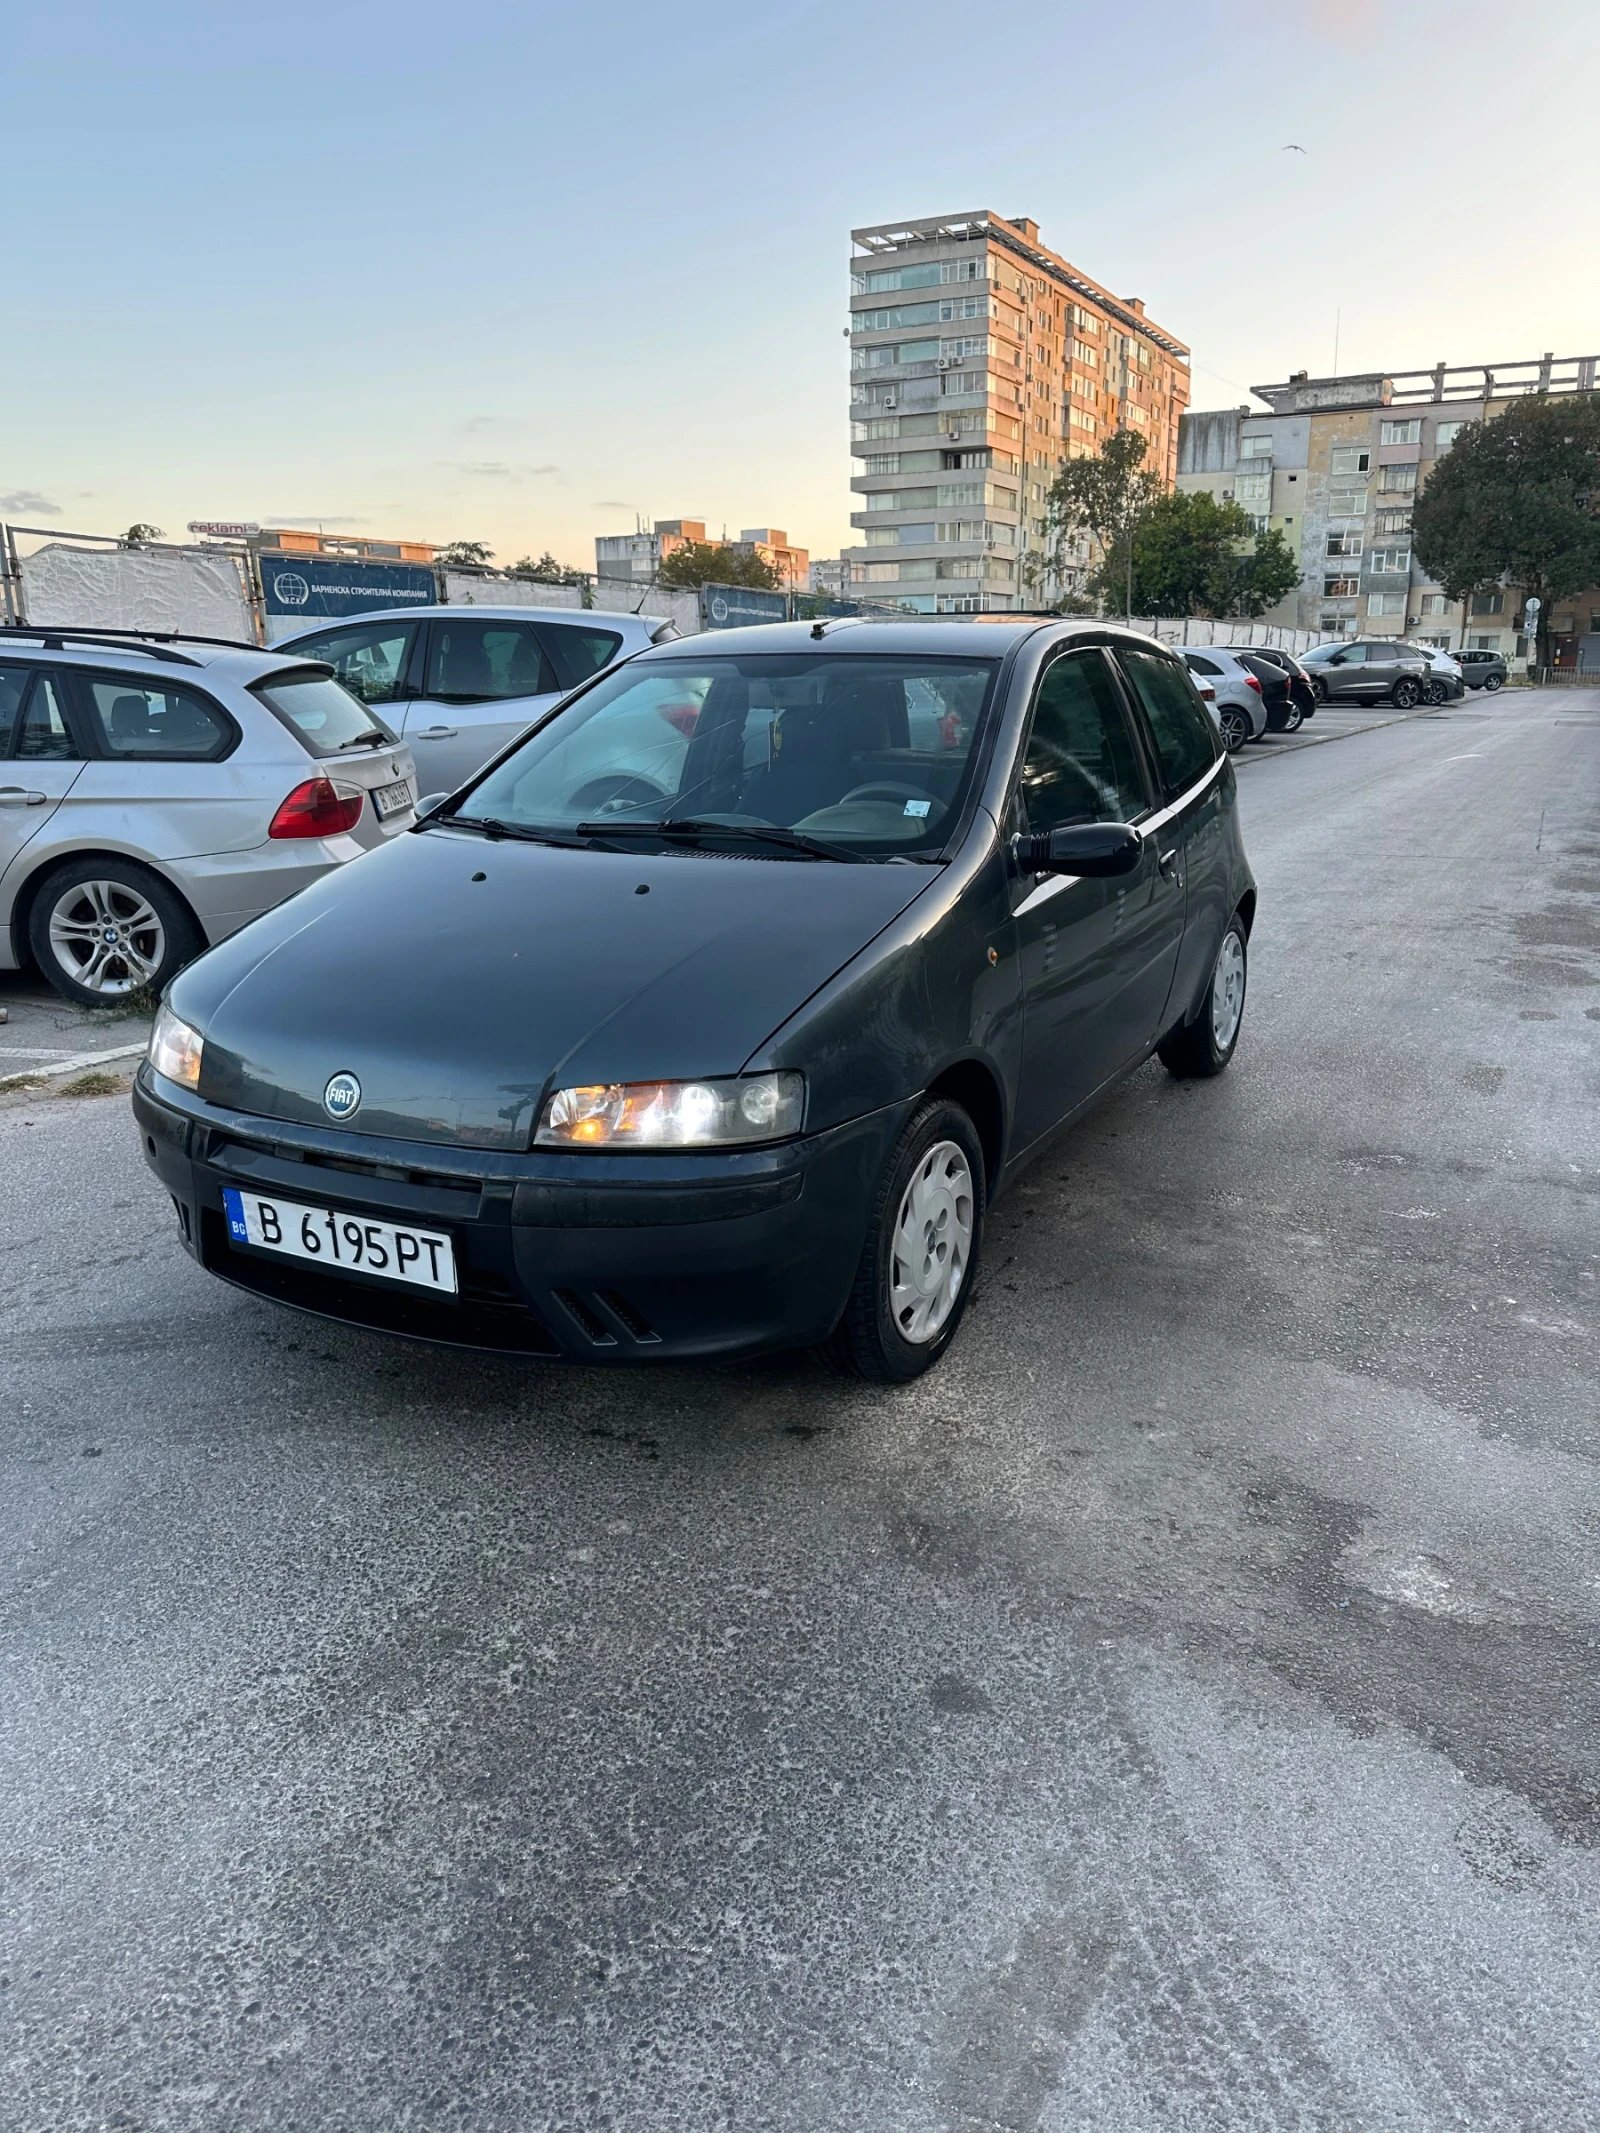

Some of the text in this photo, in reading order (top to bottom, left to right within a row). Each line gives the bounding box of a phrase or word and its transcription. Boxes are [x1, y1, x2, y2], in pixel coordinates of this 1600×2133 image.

[311, 584, 428, 599] ВАРНЕНСКА СТРОИТЕЛНА КОМПАНИЯ
[329, 1087, 354, 1104] FIAT
[232, 1220, 246, 1235] BG
[257, 1201, 282, 1244] B
